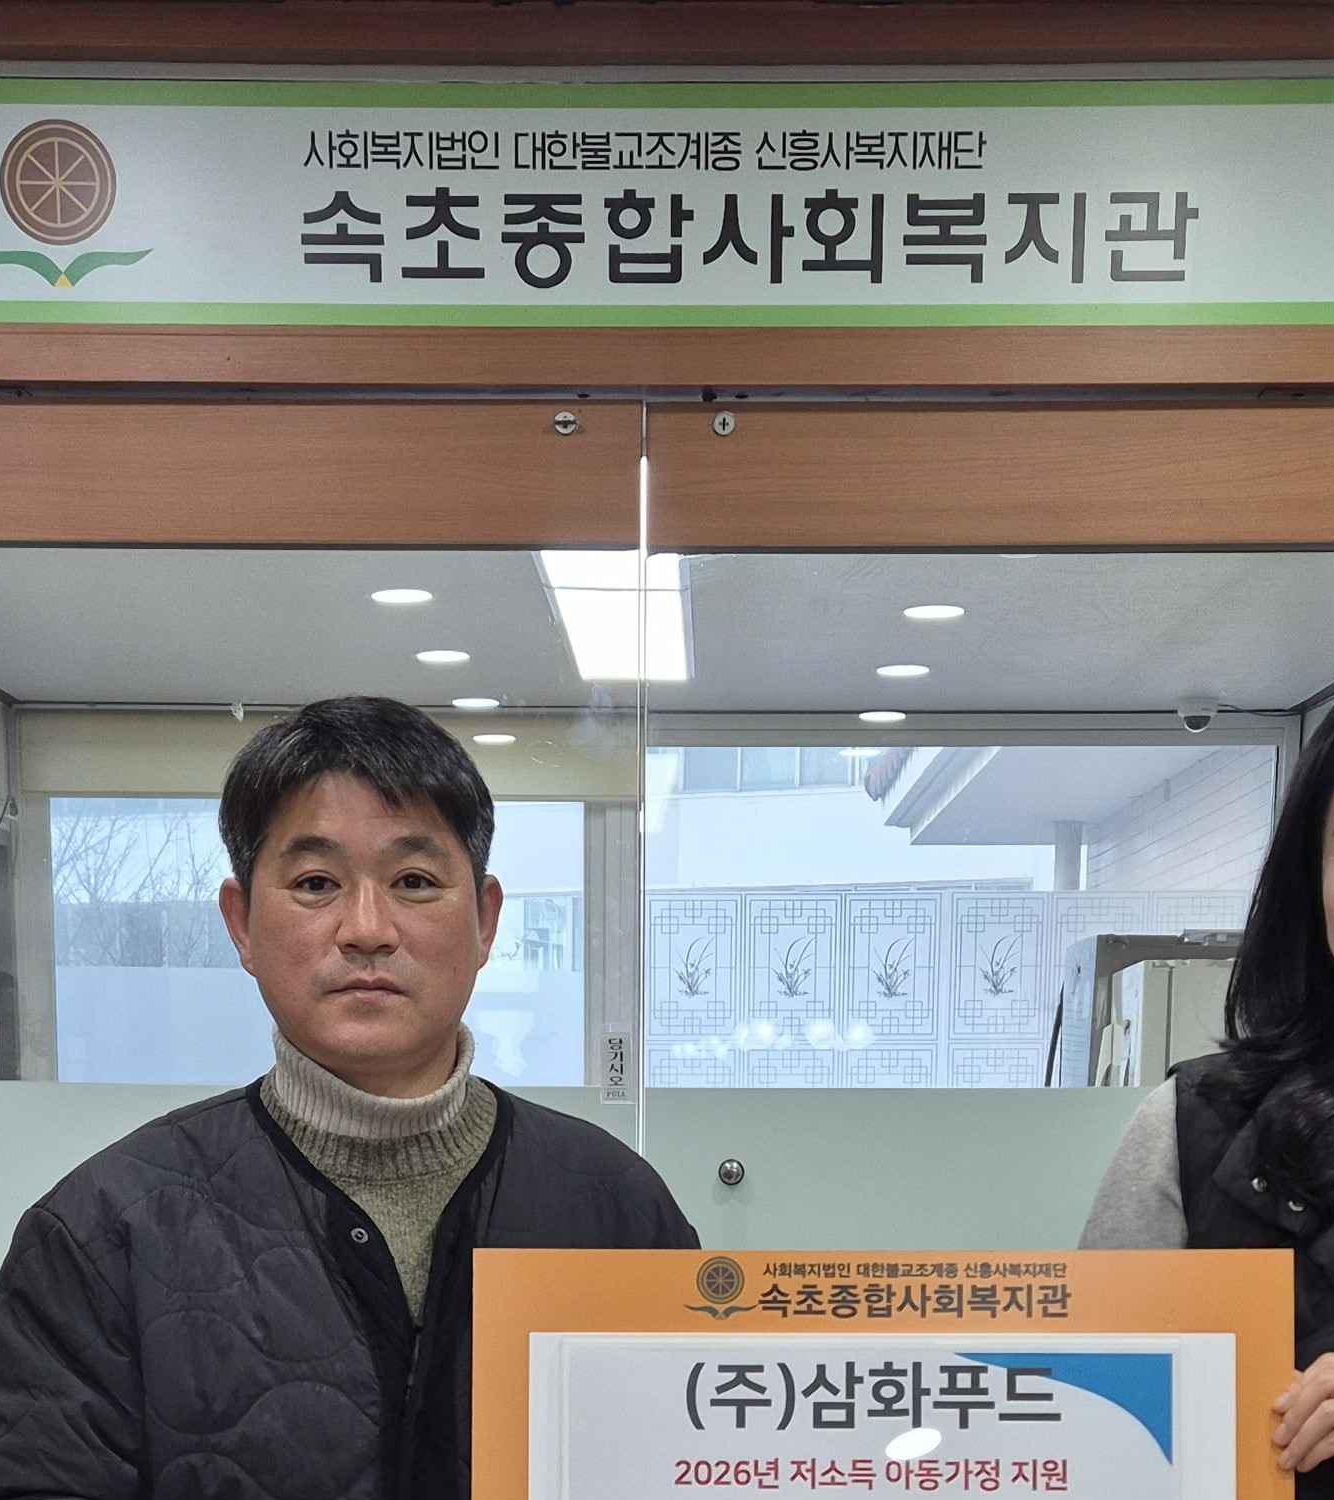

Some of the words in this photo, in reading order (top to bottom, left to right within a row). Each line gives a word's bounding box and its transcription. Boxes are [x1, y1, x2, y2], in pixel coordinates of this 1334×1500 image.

[303, 129, 500, 171] 사회복지법인
[515, 129, 743, 172] 대한불교조계종
[755, 129, 988, 172] 신흥사복지재단
[300, 186, 1199, 289] 속초종합사회복지관
[608, 1037, 624, 1086] 당기시오
[606, 1090, 627, 1098] PULL
[762, 1262, 851, 1279] 사회복지법인
[856, 1262, 958, 1279] 대한불교조계종
[964, 1262, 1068, 1280] 신흥사복지재단
[758, 1283, 1072, 1319] 속초종합사회복지관
[685, 1360, 1062, 1433] (주)삼화푸드
[674, 1457, 780, 1490] 2026년
[789, 1457, 877, 1491] 저소득
[885, 1458, 1000, 1492] 아동가정
[1010, 1458, 1068, 1492] 지원
